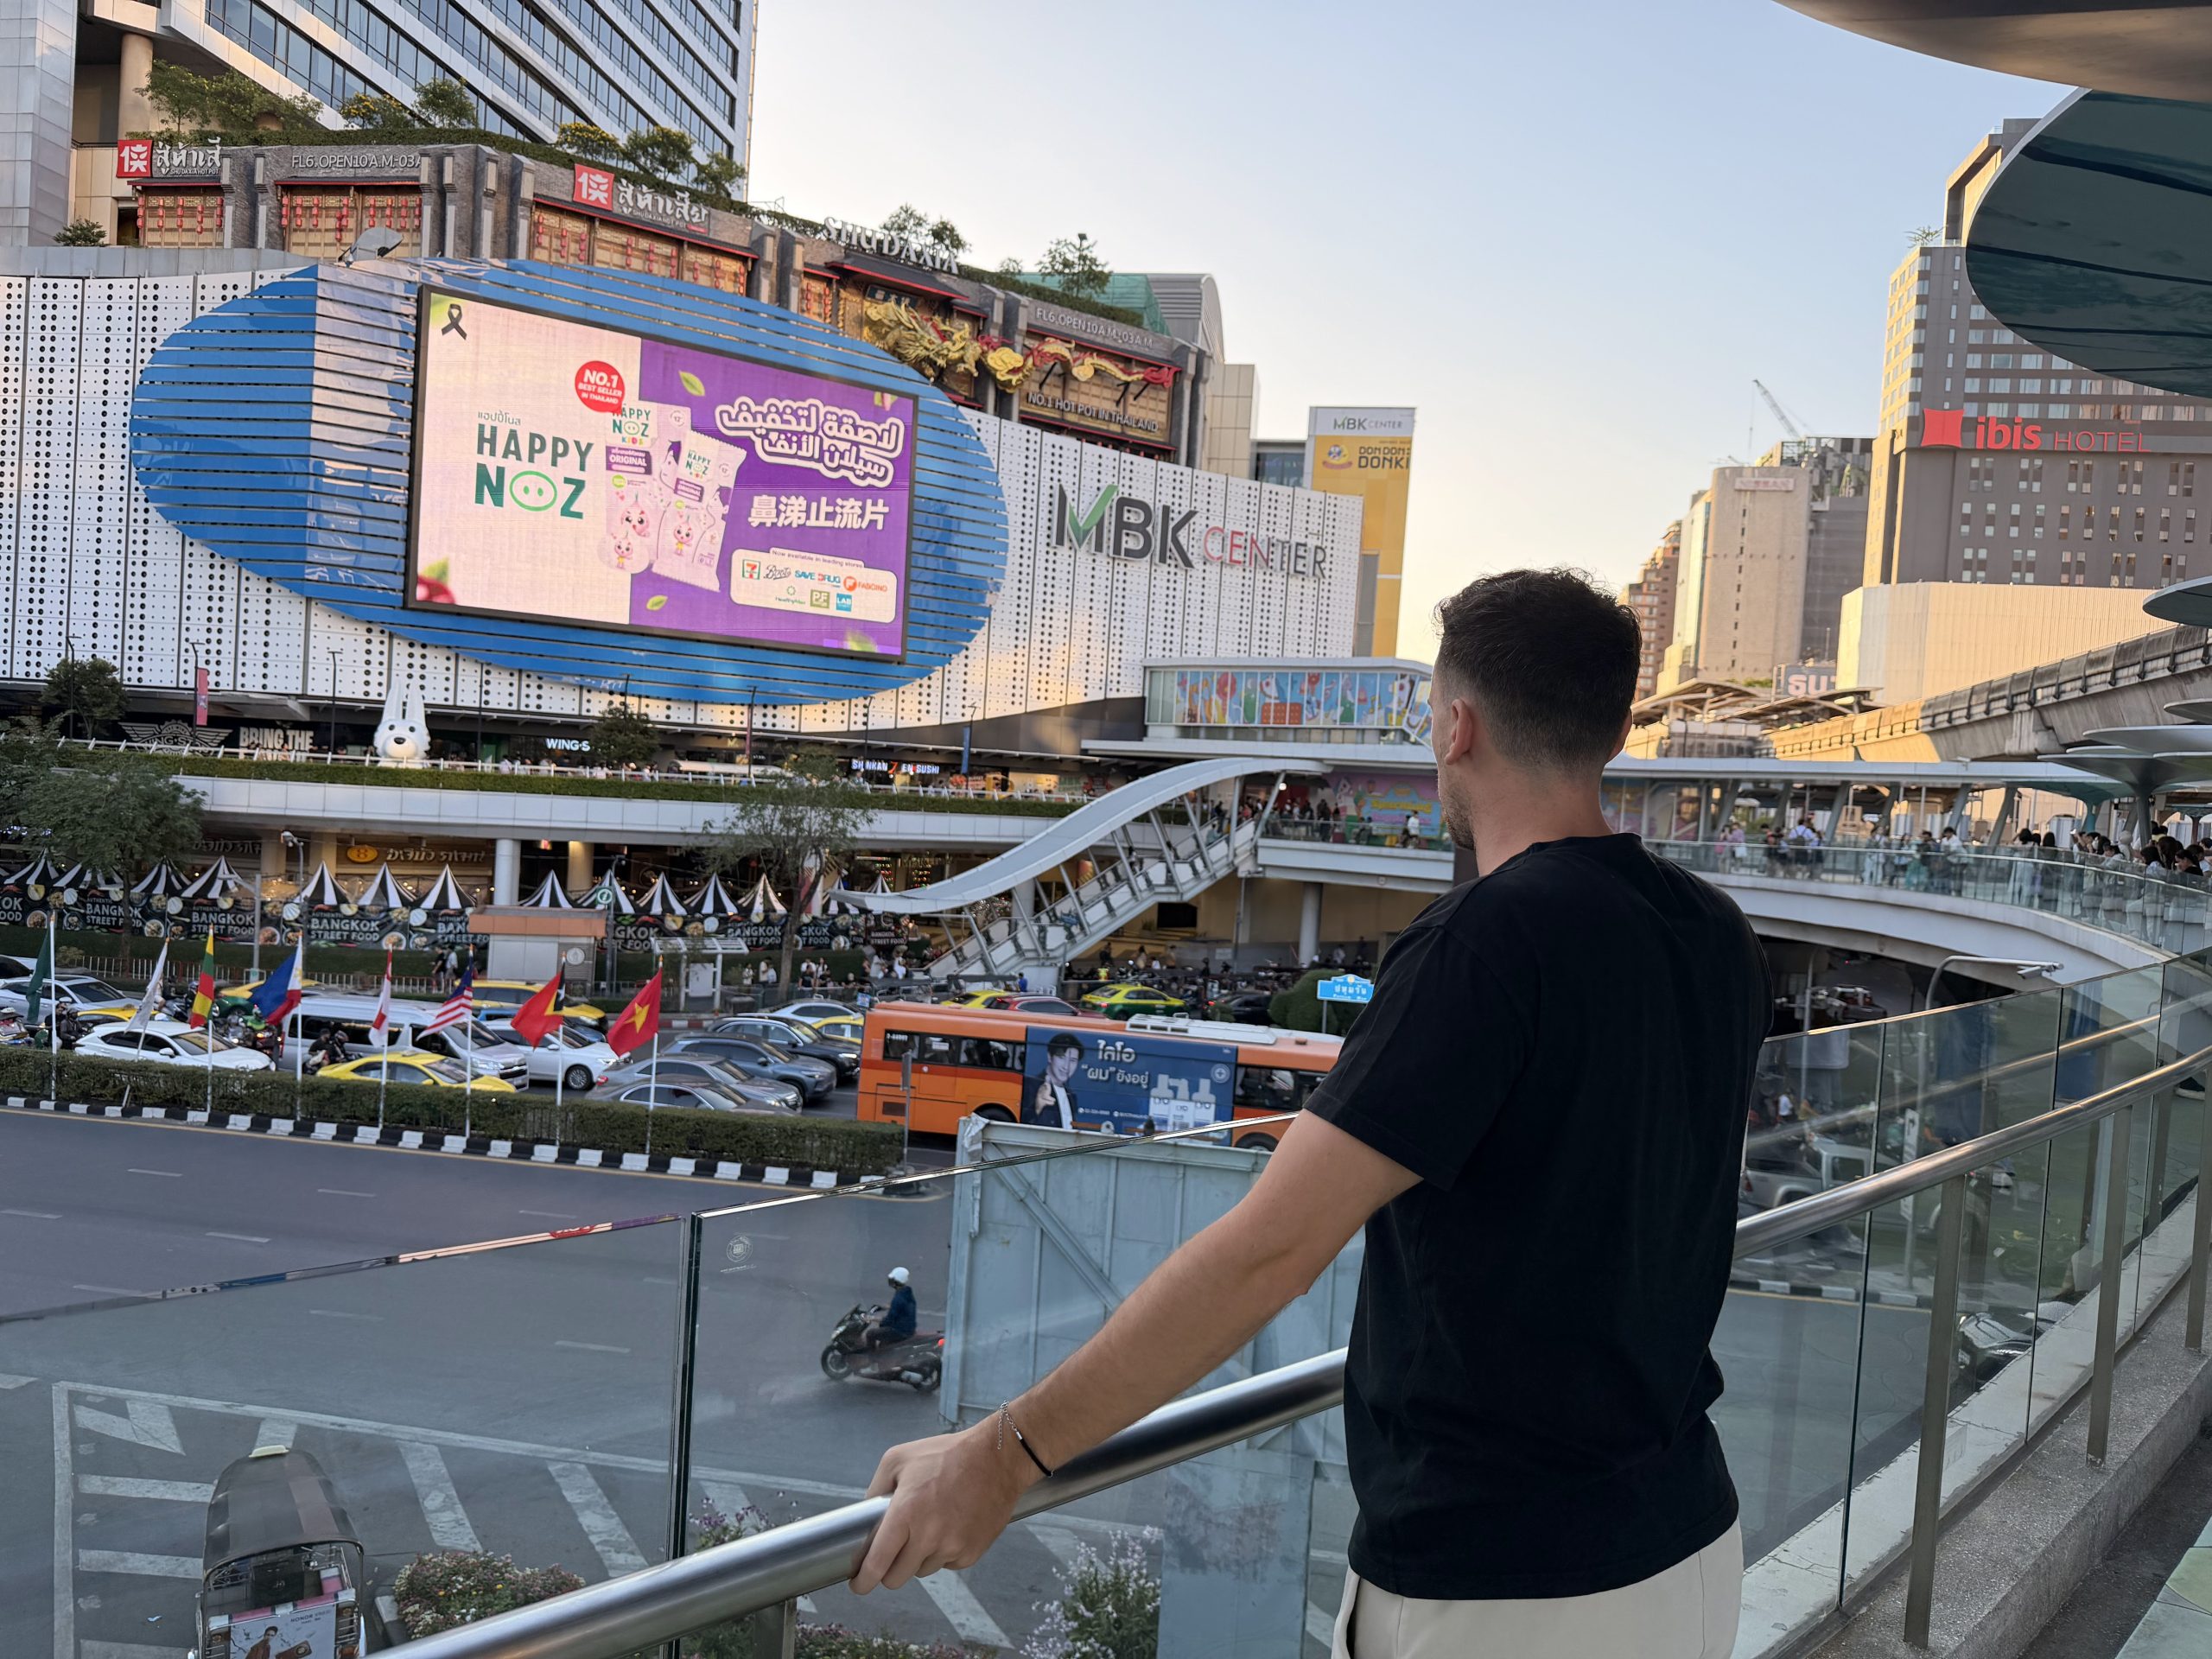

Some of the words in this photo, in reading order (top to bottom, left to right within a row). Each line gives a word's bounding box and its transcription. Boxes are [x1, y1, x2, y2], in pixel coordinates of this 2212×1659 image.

[583, 369, 619, 390] NO.1
[578, 382, 597, 393] BEST
[598, 385, 622, 397] SELLER
[722, 404, 817, 435] لتخفيف
[1055, 398, 1076, 412] HOT
[1077, 403, 1096, 417] POT
[1098, 407, 1109, 421] IN
[1109, 410, 1159, 432] THAILAND
[1333, 416, 1367, 430] MBK
[1368, 420, 1403, 429] CENTER
[823, 413, 898, 451] لاصقة
[1975, 415, 2043, 450] ibis
[2054, 430, 2152, 453] HOTEL
[477, 423, 594, 472] HAPPY
[1359, 446, 1382, 454] DON
[608, 454, 647, 467] ORIGINAL
[823, 442, 886, 477] سيلان
[1051, 483, 1199, 569] MBK
[1204, 525, 1328, 580] CENTER
[794, 570, 816, 582] SAVE
[1788, 674, 1836, 696] SU
[286, 730, 315, 751] THE
[916, 765, 940, 774] SUSHI
[86, 916, 115, 925] STREET
[192, 912, 256, 926] BANGKOK
[311, 918, 379, 931] BANGKOK
[227, 925, 256, 936] FOOD
[310, 931, 348, 940] STREET
[351, 931, 380, 942] FOOD
[627, 939, 651, 950] FOO
[1096, 1039, 1136, 1063] ไลโอ
